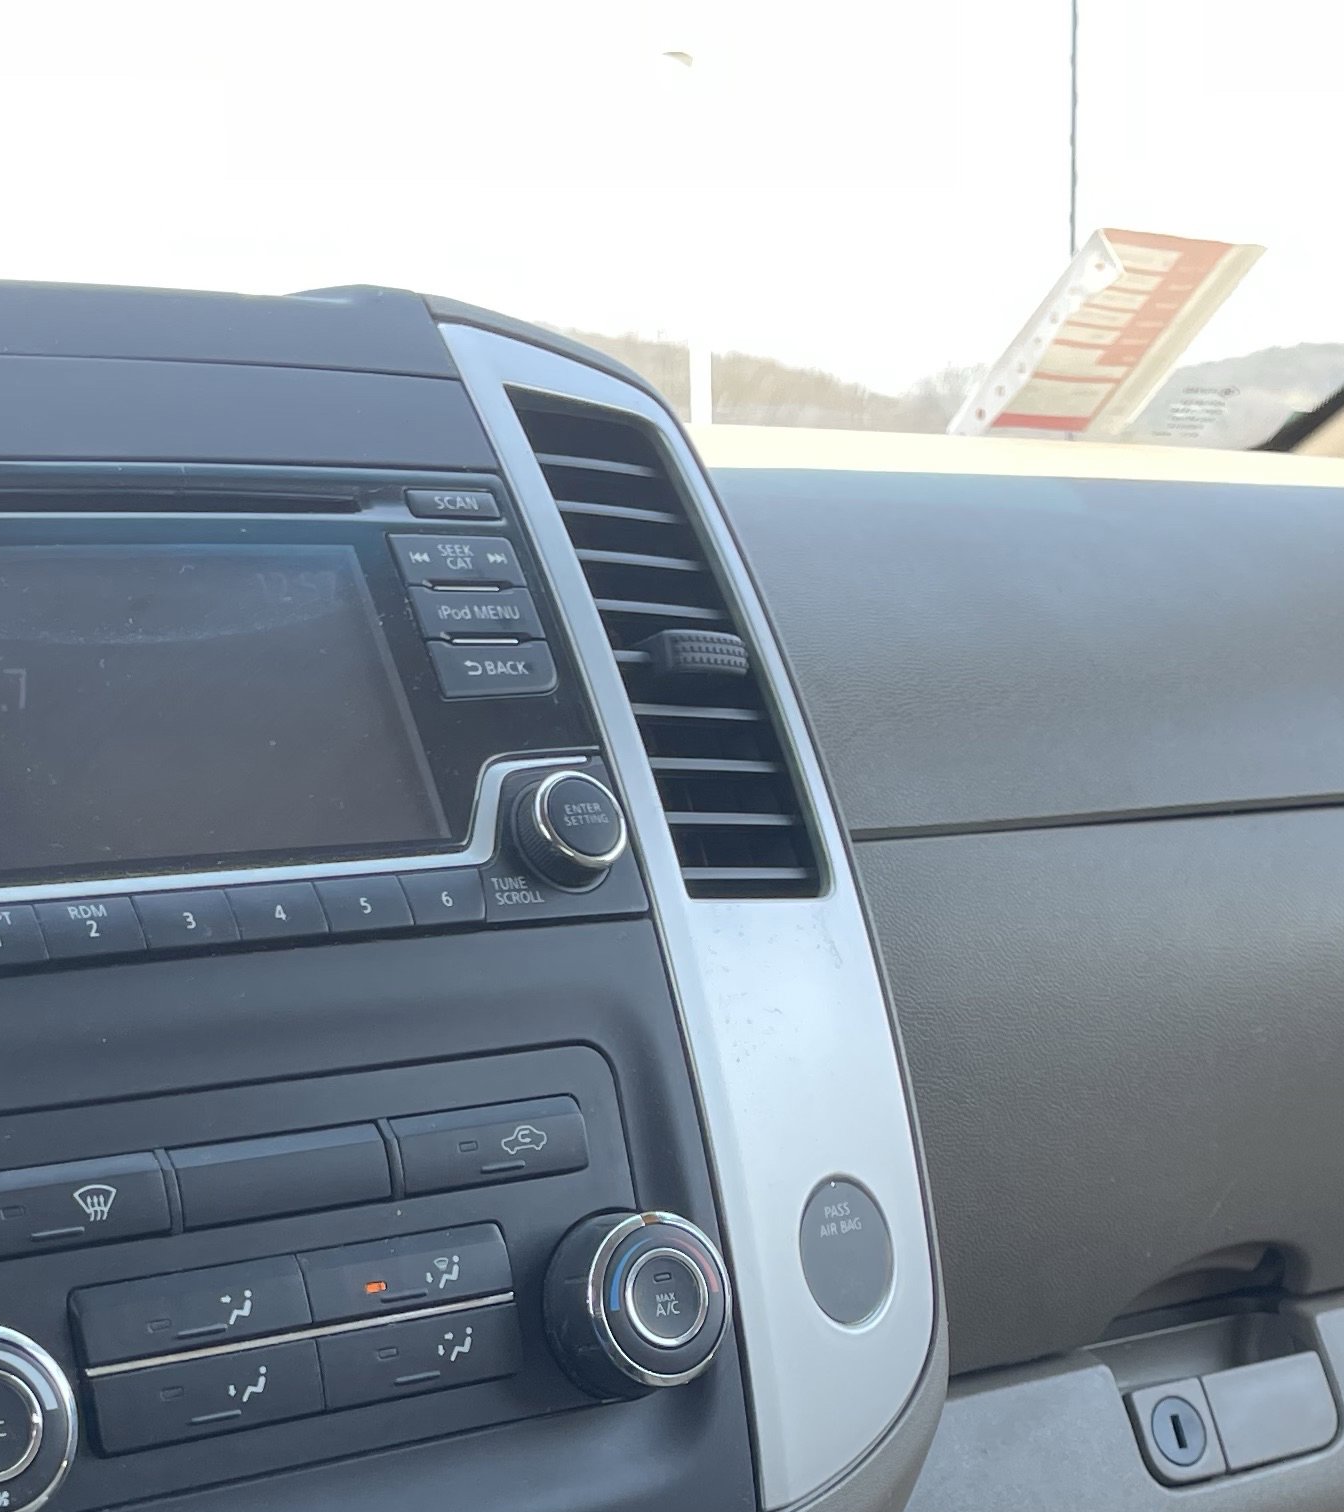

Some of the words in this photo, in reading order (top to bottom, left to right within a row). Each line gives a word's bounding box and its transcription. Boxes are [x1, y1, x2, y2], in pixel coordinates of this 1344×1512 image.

[434, 496, 479, 511] SCAN
[437, 544, 474, 557] SEEK
[446, 557, 473, 570] CAT
[438, 605, 471, 620] iPod
[474, 605, 520, 620] MENU
[484, 660, 529, 675] BACK
[564, 802, 601, 815] ENTER
[564, 814, 608, 826] SETTING
[491, 876, 528, 890] TUNE
[441, 890, 453, 908] 6
[496, 891, 544, 905] SCROLL
[67, 904, 108, 920] RDM
[274, 903, 287, 921] 4
[360, 897, 372, 915] 5
[183, 912, 197, 929] 3
[86, 920, 100, 938] 2
[824, 1202, 850, 1218] PASS
[820, 1222, 838, 1237] AIR
[840, 1217, 862, 1233] BAG
[656, 1292, 676, 1302] MAX
[656, 1301, 680, 1317] A/C
